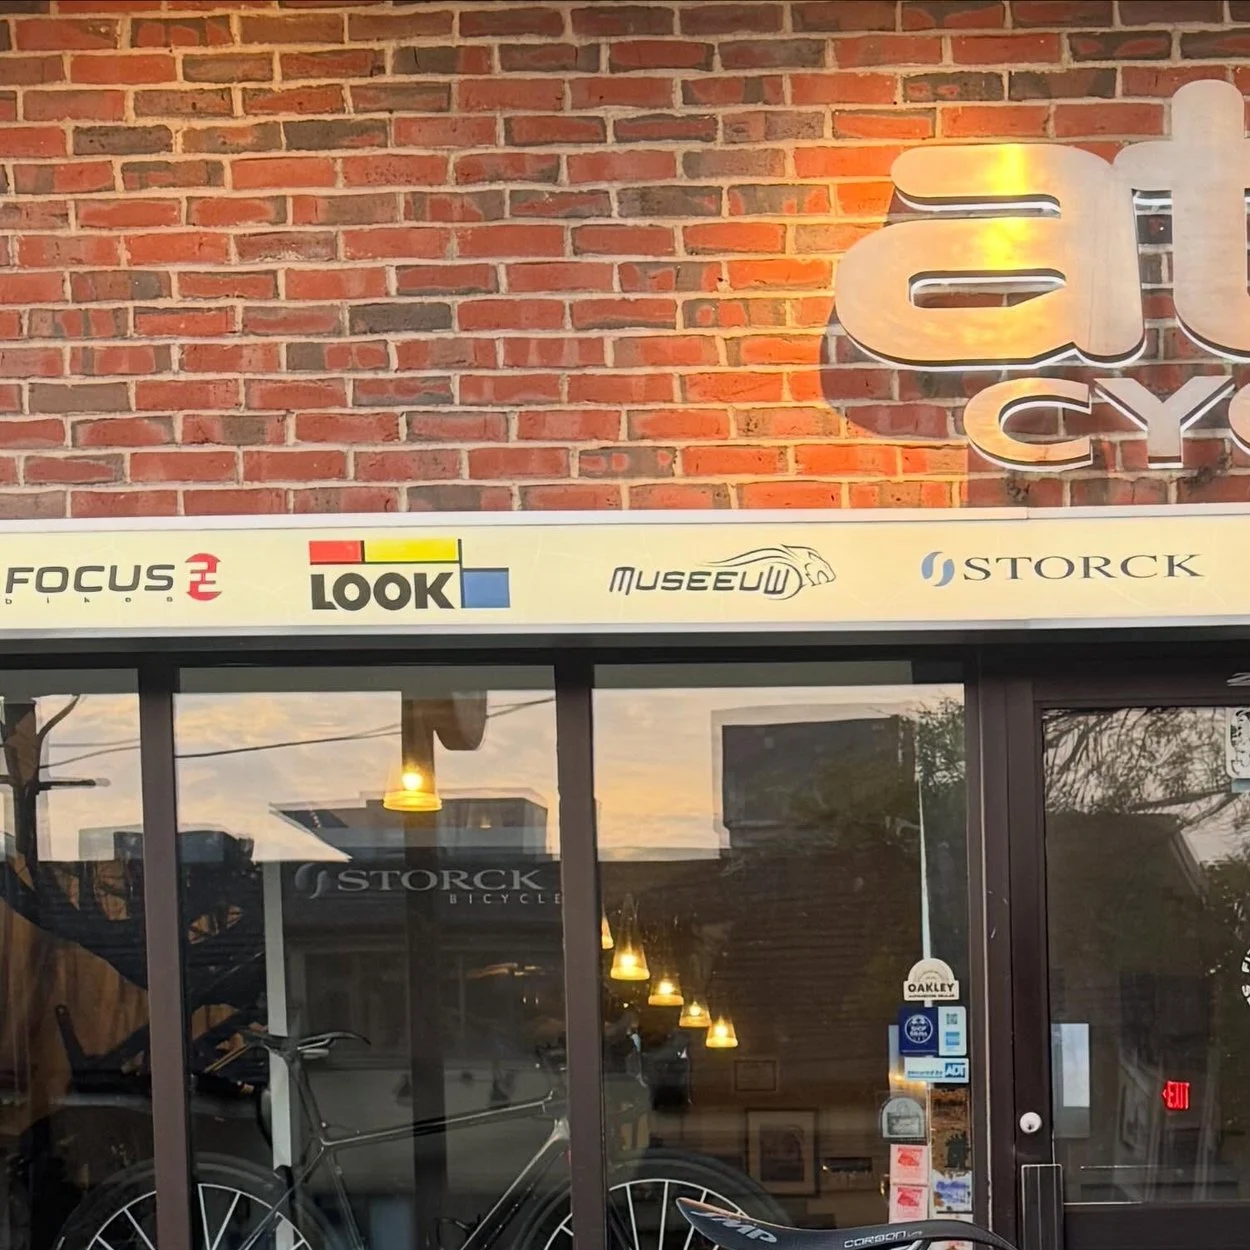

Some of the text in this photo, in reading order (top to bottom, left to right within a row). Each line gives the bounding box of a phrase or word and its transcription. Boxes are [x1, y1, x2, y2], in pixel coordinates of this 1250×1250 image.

[5, 564, 175, 594] FOCUS
[963, 553, 1205, 582] STORCK
[310, 571, 455, 611] LOOK
[338, 869, 547, 891] STORCK
[907, 983, 955, 993] OAKLEY
[945, 1063, 966, 1077] ADT
[1167, 1081, 1190, 1109] EXIT
